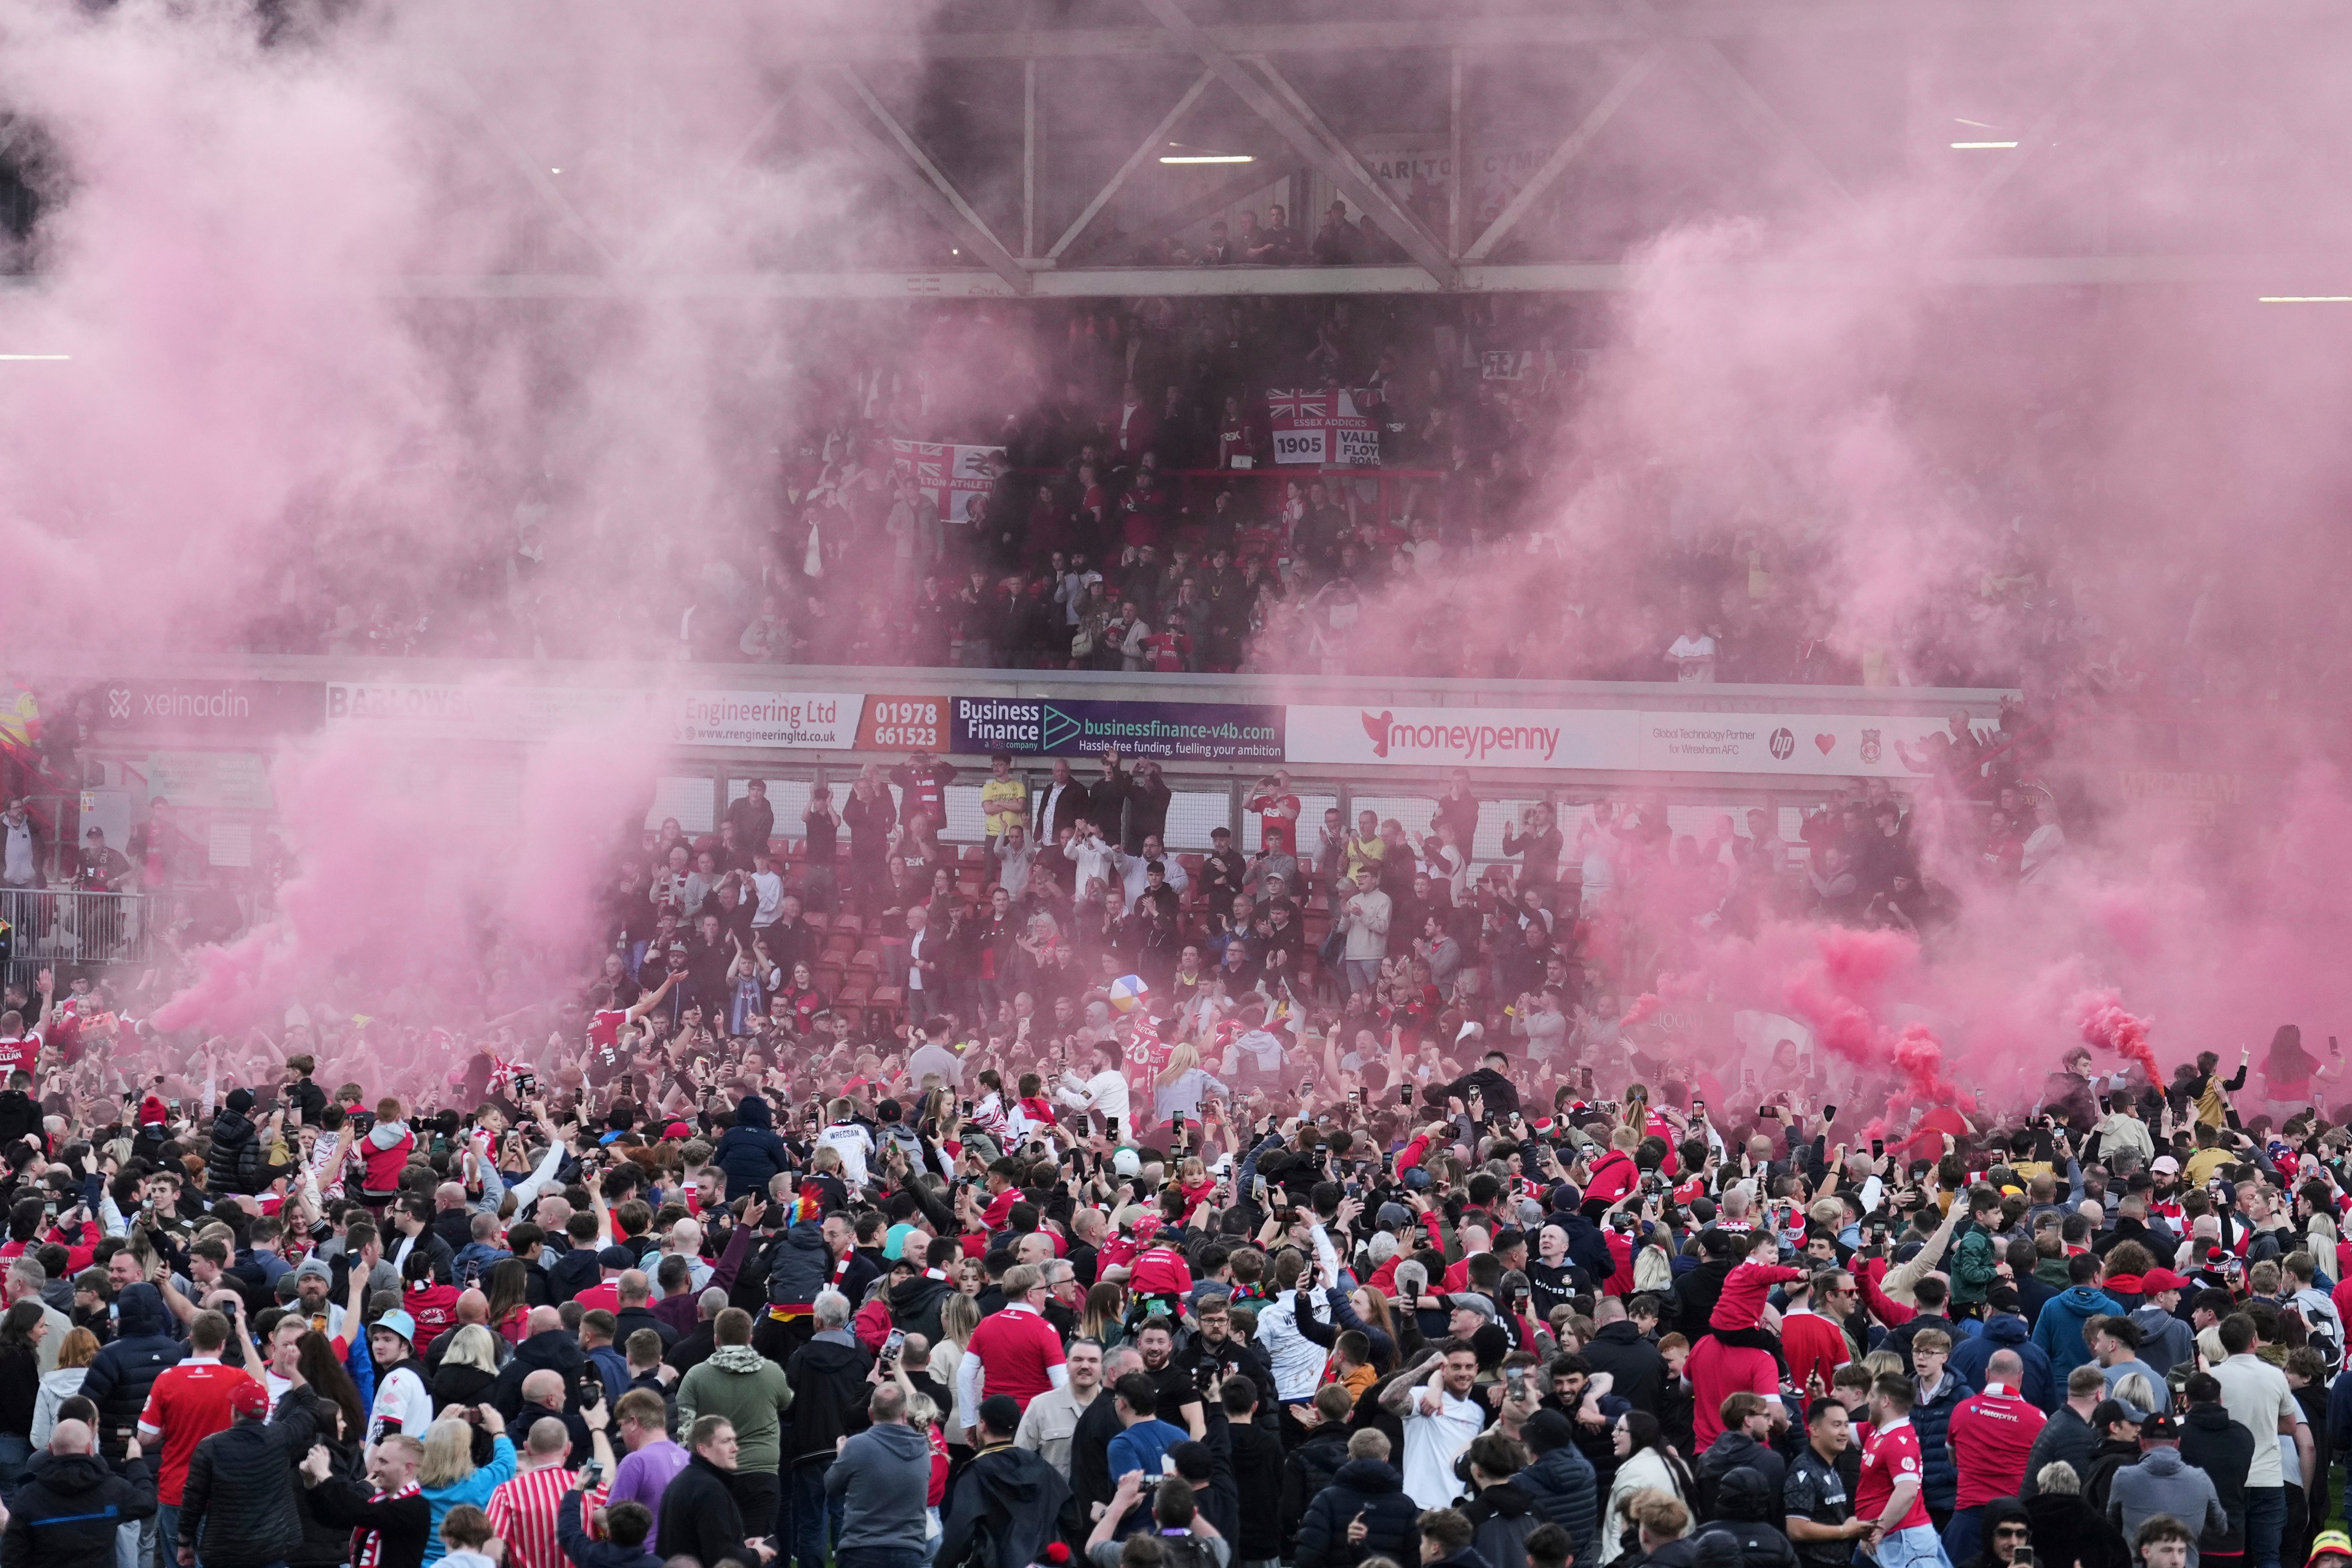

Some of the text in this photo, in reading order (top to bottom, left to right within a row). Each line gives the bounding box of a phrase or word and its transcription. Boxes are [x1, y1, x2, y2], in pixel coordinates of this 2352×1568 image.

[1369, 158, 1451, 180] ARLTO
[1325, 418, 1367, 427] ADDICKS
[1277, 437, 1322, 454] 1905
[919, 477, 992, 489] LTON ATHLETI
[143, 688, 249, 718] xeinadin
[328, 686, 466, 719] BARLOWS
[686, 697, 836, 728] Engineering Ltd
[959, 700, 1039, 721] Business
[876, 702, 937, 725] 01978
[698, 728, 836, 743] www.rrengineeringltd.co.uk
[875, 726, 936, 746] 661523
[968, 719, 1039, 741] Finance
[1085, 718, 1275, 740] businessfinance-v4b.com
[1653, 728, 1756, 742] Global Technology Partner
[1006, 741, 1038, 751] company
[1079, 740, 1281, 758] Hassle-free funding, fuelling your ambition
[1391, 725, 1560, 761] moneypenny
[1669, 744, 1739, 754] for Wrexham AFC
[1772, 728, 1793, 760] hp
[1126, 1038, 1151, 1064] 26
[829, 1130, 860, 1140] WRECSAM
